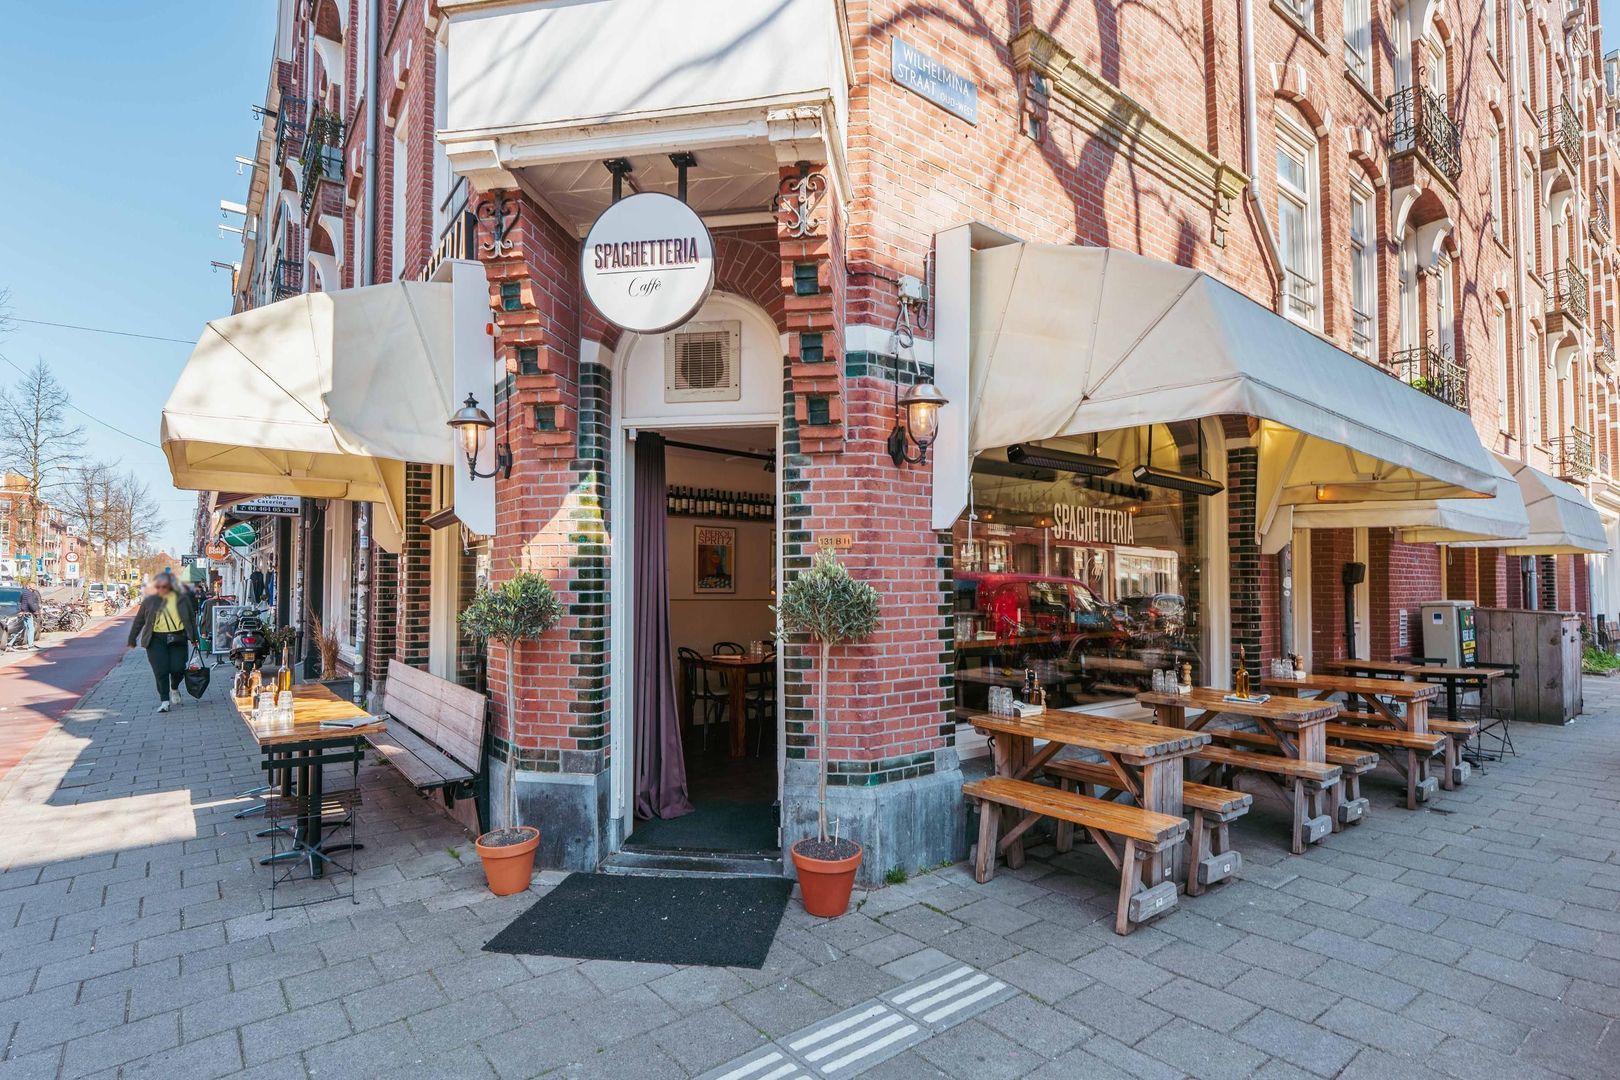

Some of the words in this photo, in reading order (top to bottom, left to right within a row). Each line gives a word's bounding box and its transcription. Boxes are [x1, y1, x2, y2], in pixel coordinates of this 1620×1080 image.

[903, 46, 969, 97] WILHELMINA
[898, 63, 937, 95] STRAAT
[940, 92, 974, 117] OUD-WEST
[594, 237, 699, 269] SPAGHETTERIA
[628, 276, 662, 297] Caffè
[699, 528, 732, 540] APEROL
[1054, 503, 1134, 545] SPAGHETTERIA
[698, 536, 732, 545] SPRITZ
[820, 537, 833, 545] 131
